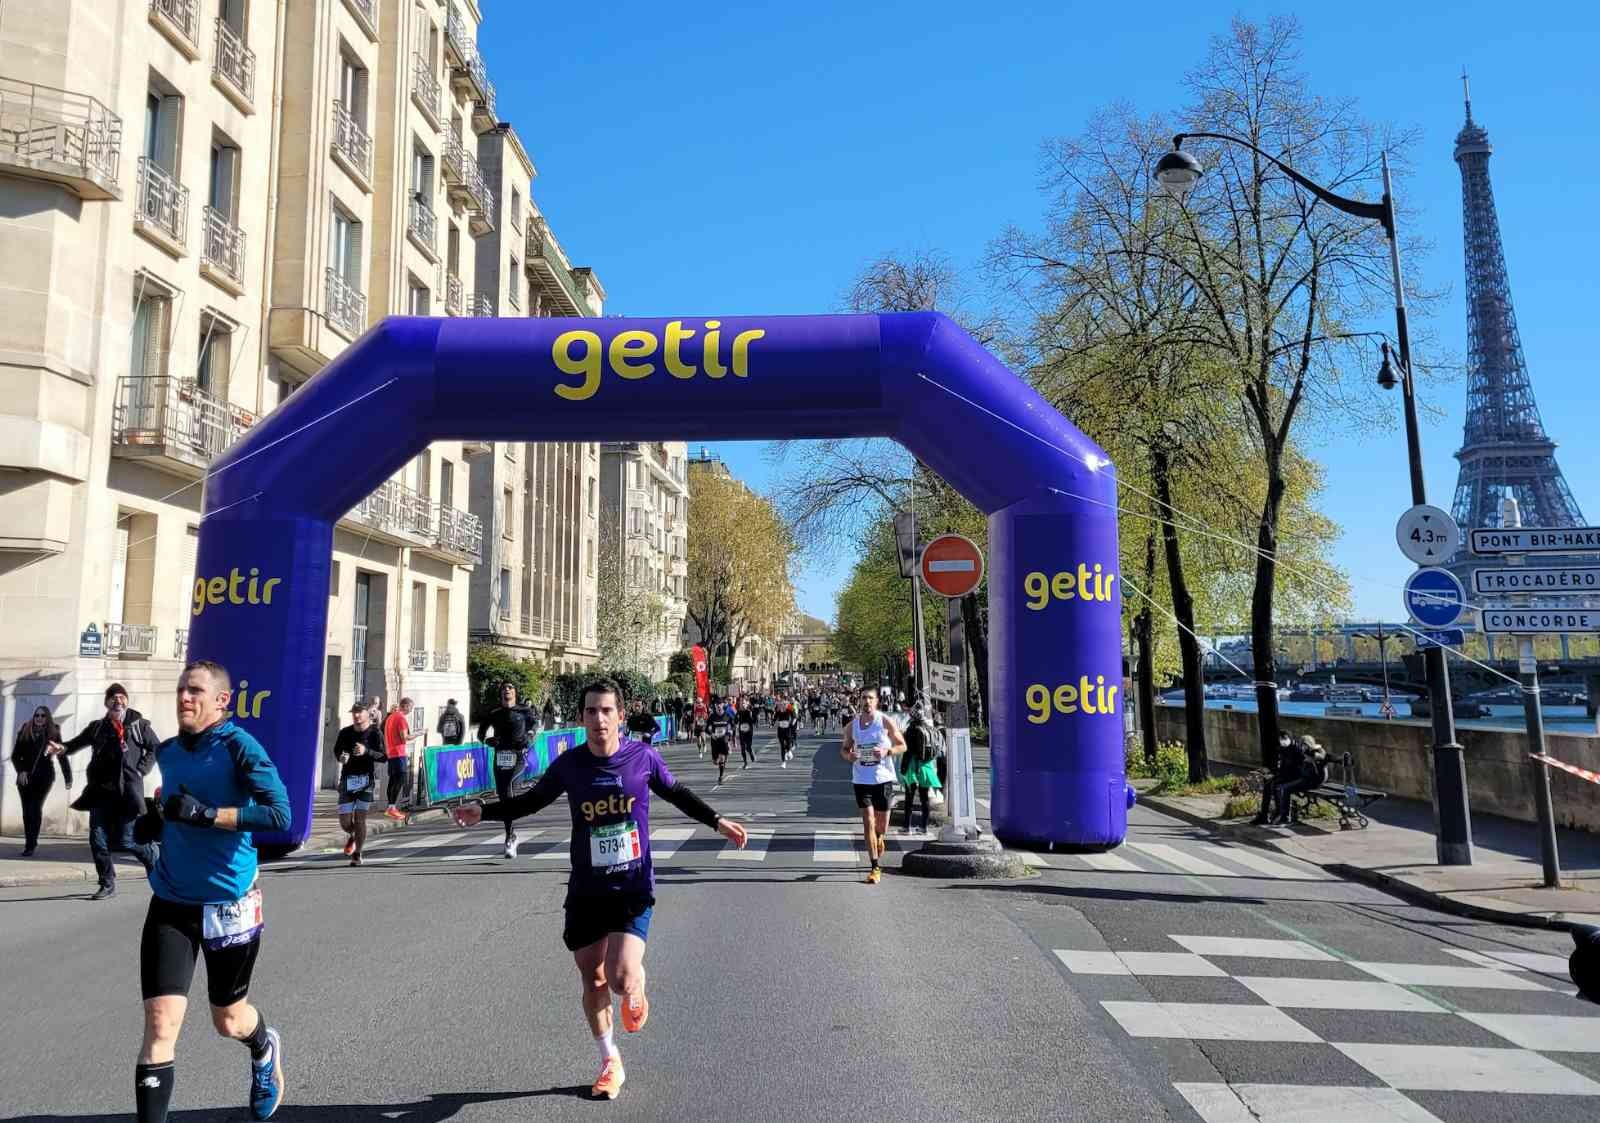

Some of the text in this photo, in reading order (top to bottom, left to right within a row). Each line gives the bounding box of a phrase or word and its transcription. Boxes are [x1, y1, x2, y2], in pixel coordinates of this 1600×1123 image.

[551, 319, 766, 401] getir
[1480, 535, 1521, 547] PONT
[192, 567, 282, 616] getir
[1024, 562, 1114, 611] getir
[1485, 571, 1596, 587] TROCADÉRO
[1491, 615, 1589, 627] CONCORDE
[1025, 675, 1118, 725] getir
[456, 753, 475, 788] getir
[580, 794, 636, 822] getir
[599, 836, 625, 855] 6734
